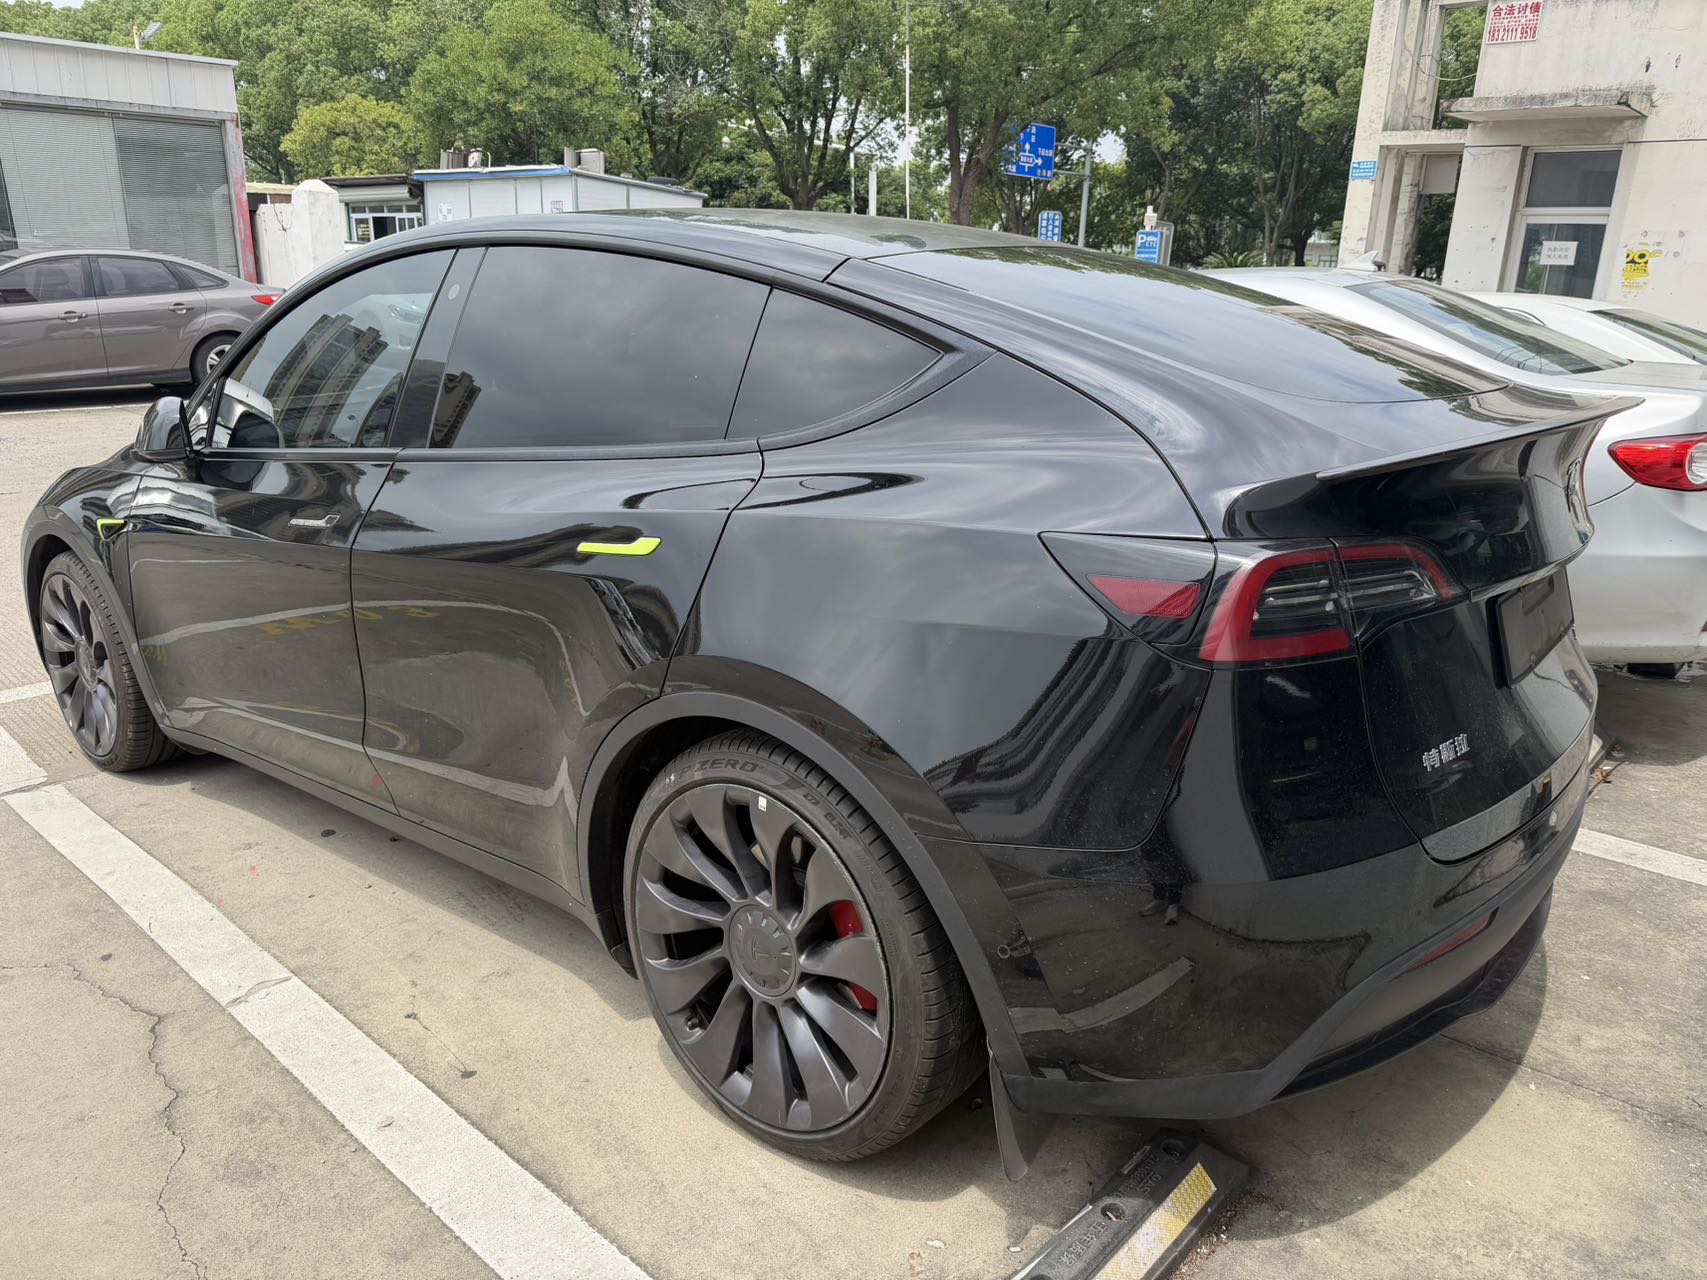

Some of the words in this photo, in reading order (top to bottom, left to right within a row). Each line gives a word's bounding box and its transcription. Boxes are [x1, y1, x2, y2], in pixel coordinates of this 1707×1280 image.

[1520, 26, 1538, 40] 9518
[695, 758, 758, 773] ZERO
[1422, 734, 1470, 772] 特斯拉
[1058, 1221, 1108, 1266] 五年质保
